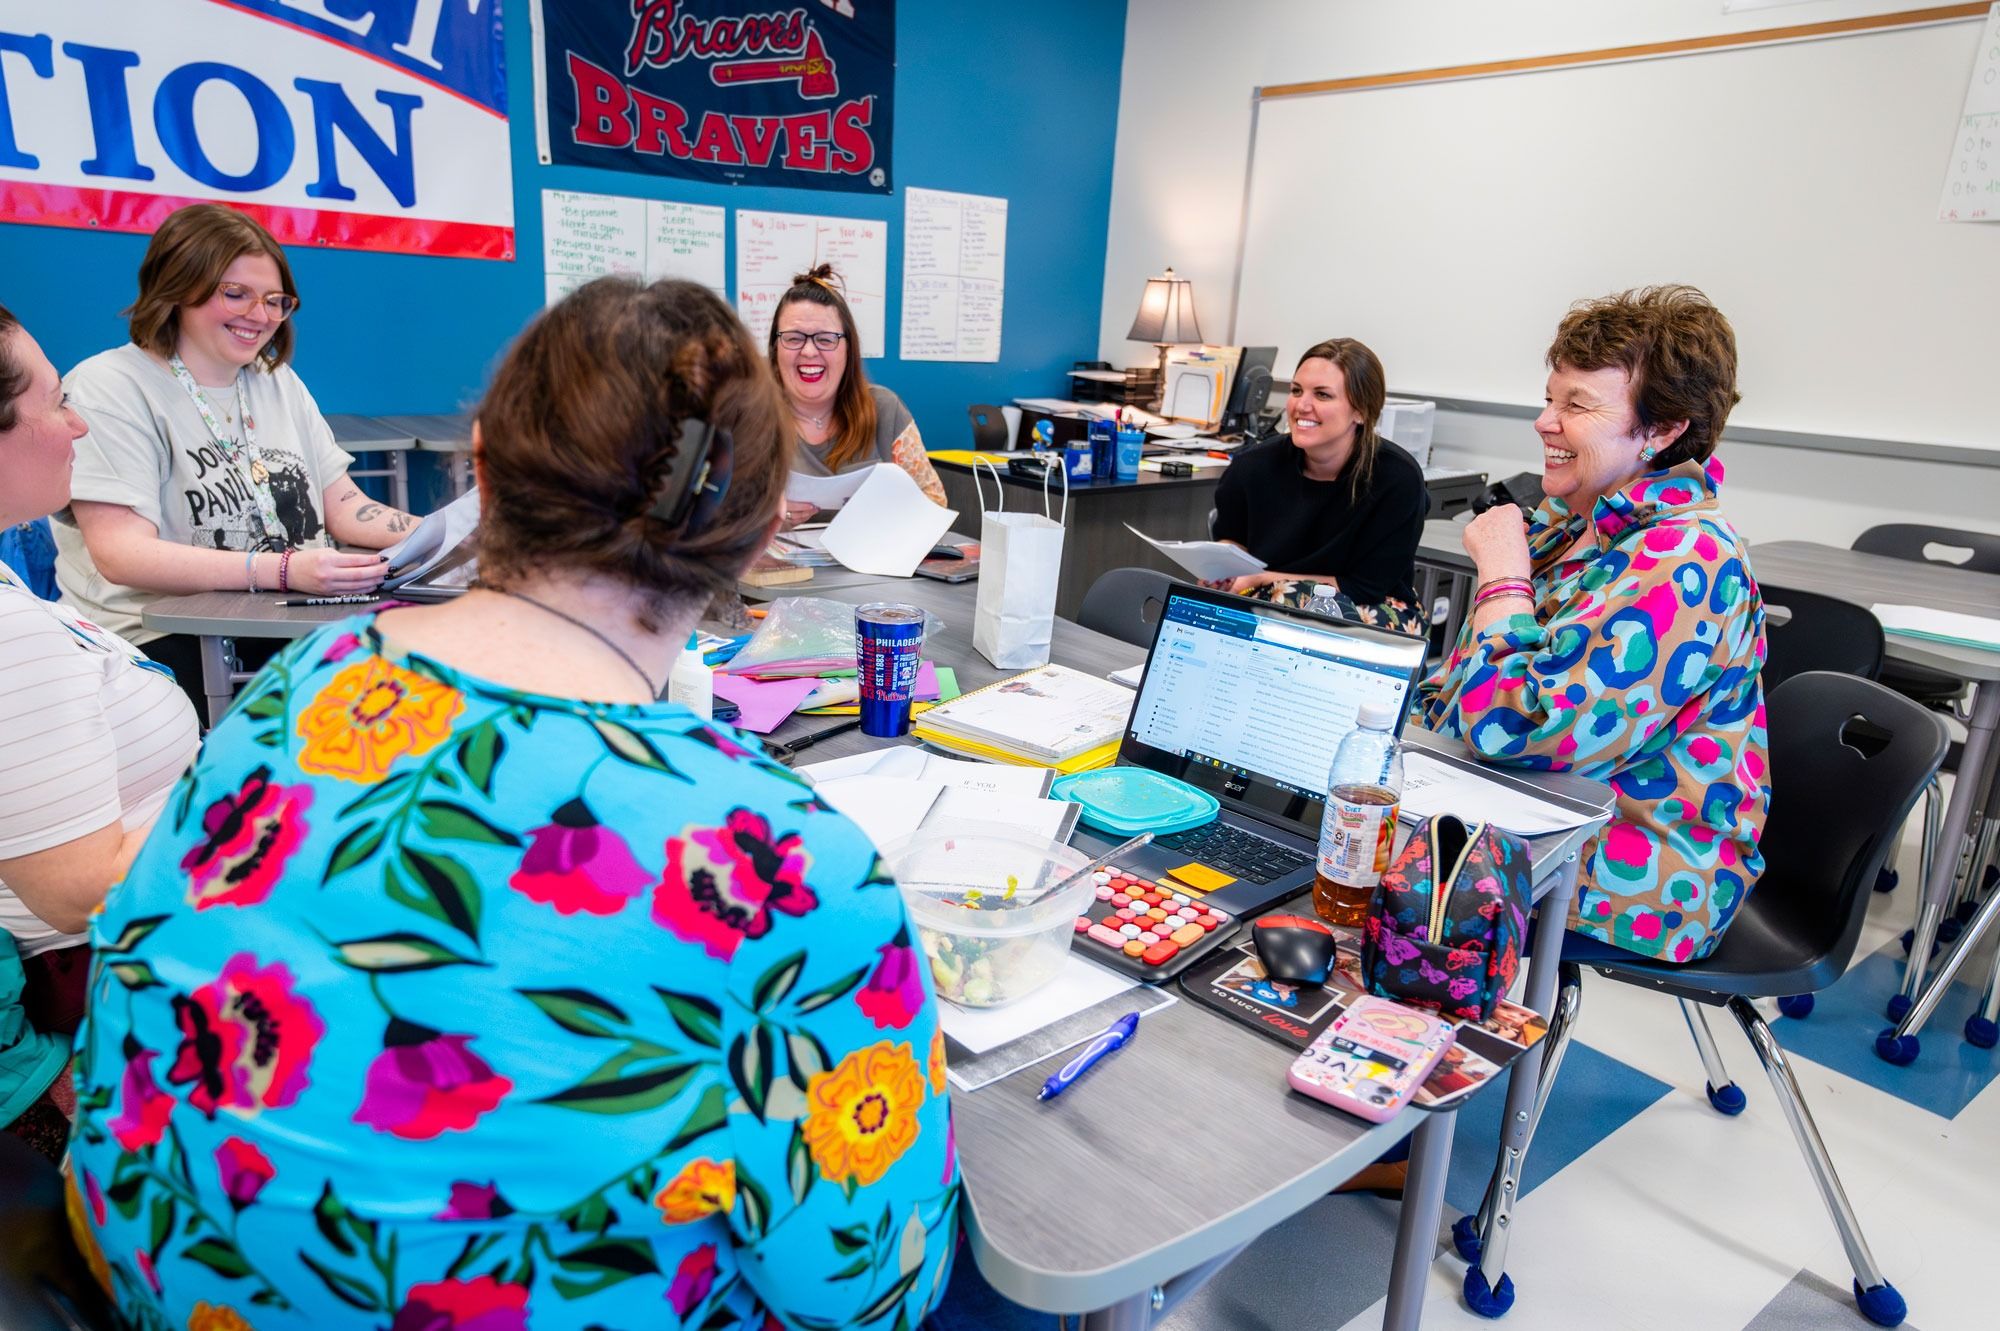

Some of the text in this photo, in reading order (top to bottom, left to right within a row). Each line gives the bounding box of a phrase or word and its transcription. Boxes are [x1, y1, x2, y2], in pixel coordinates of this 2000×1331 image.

[624, 0, 808, 77] Braves
[566, 50, 876, 175] BRAVES
[560, 219, 587, 230] Have
[863, 637, 876, 688] PHILLIES
[875, 653, 885, 672] 1883
[1224, 781, 1246, 793] acer
[1211, 988, 1310, 1038] SO MUCH love
